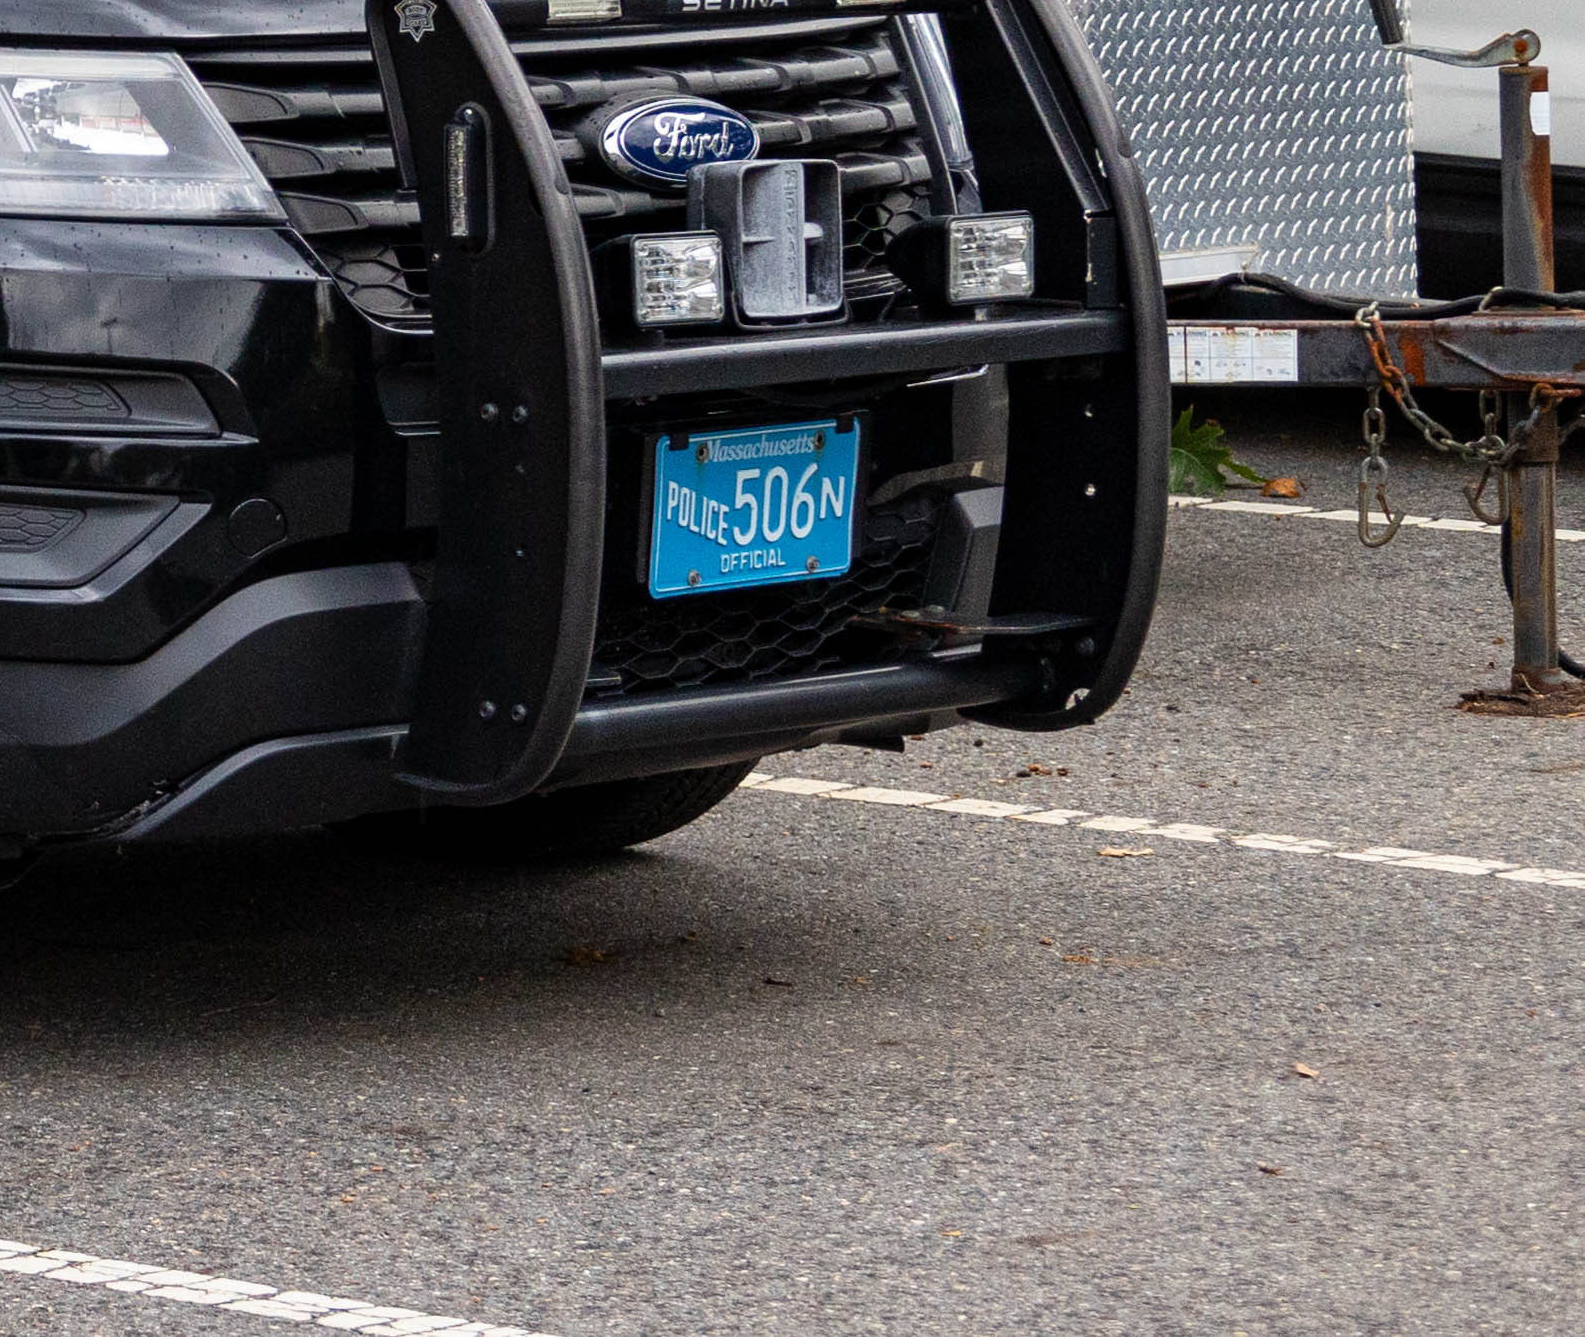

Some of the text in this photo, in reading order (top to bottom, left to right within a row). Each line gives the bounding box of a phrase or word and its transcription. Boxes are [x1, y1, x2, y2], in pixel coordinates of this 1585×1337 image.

[653, 112, 735, 162] Ford
[706, 433, 815, 463] Massachusetts
[667, 480, 730, 546] POLICE
[720, 549, 787, 574] OFFICIAL
